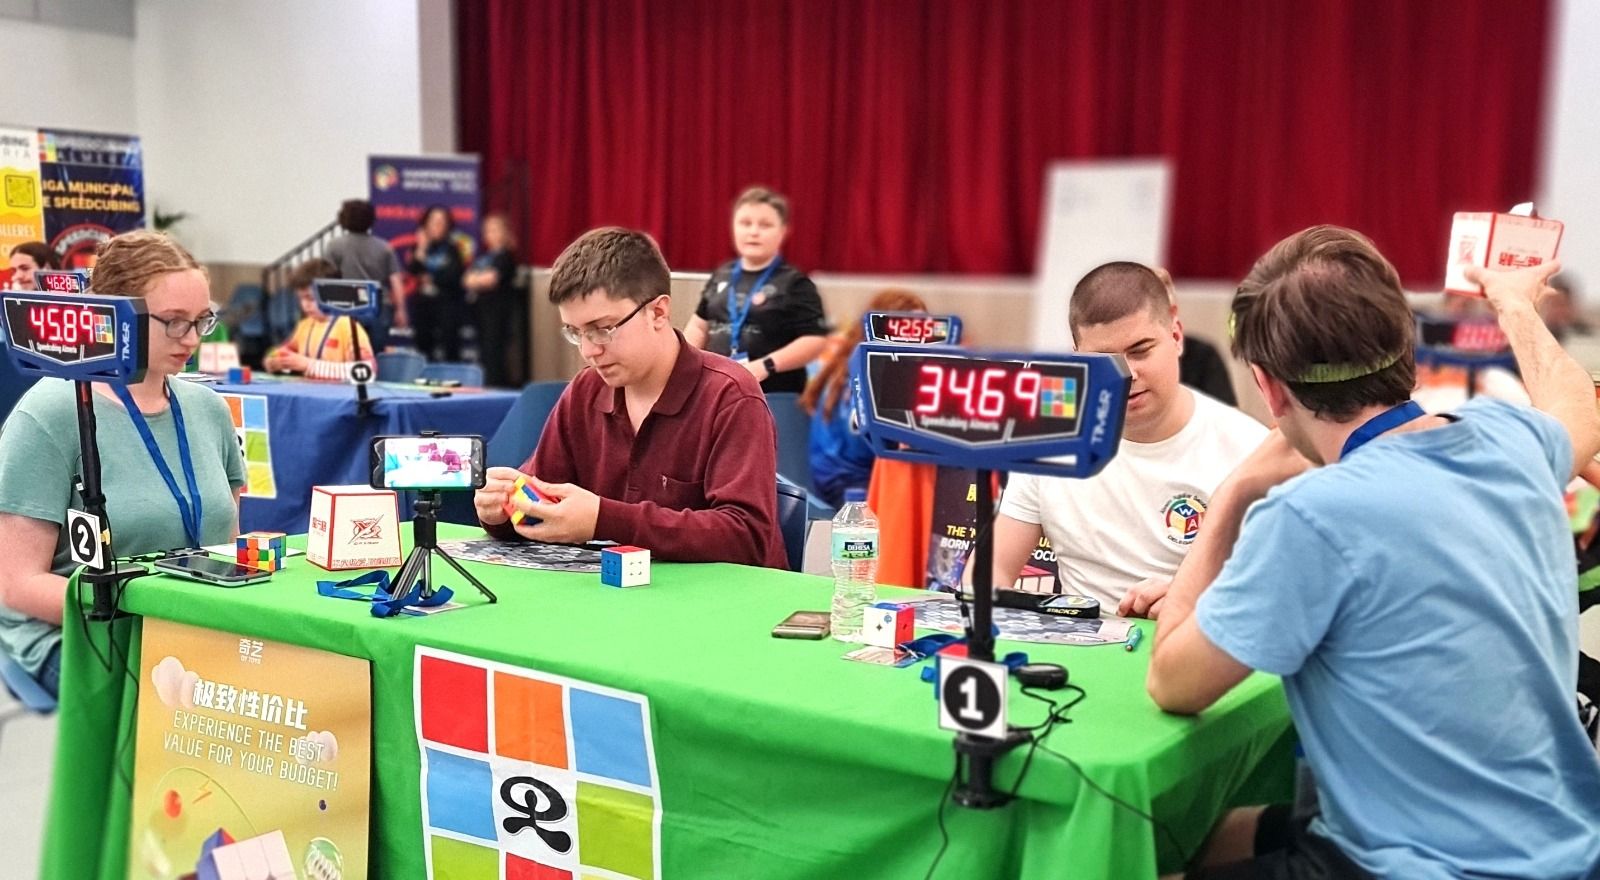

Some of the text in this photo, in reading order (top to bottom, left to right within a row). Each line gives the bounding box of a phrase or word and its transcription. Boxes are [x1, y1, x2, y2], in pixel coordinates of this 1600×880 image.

[54, 197, 140, 212] SPEEDCUBING
[69, 181, 135, 196] MUNICIPAL
[77, 524, 90, 557] 2
[940, 537, 970, 551] BORN
[946, 525, 967, 538] THE
[193, 679, 308, 730] 极致性价比
[959, 675, 984, 721] 1
[173, 710, 325, 763] EXPERIENCE THE BEST
[163, 731, 339, 791] VALUE FOR YOUR BUDGET!
